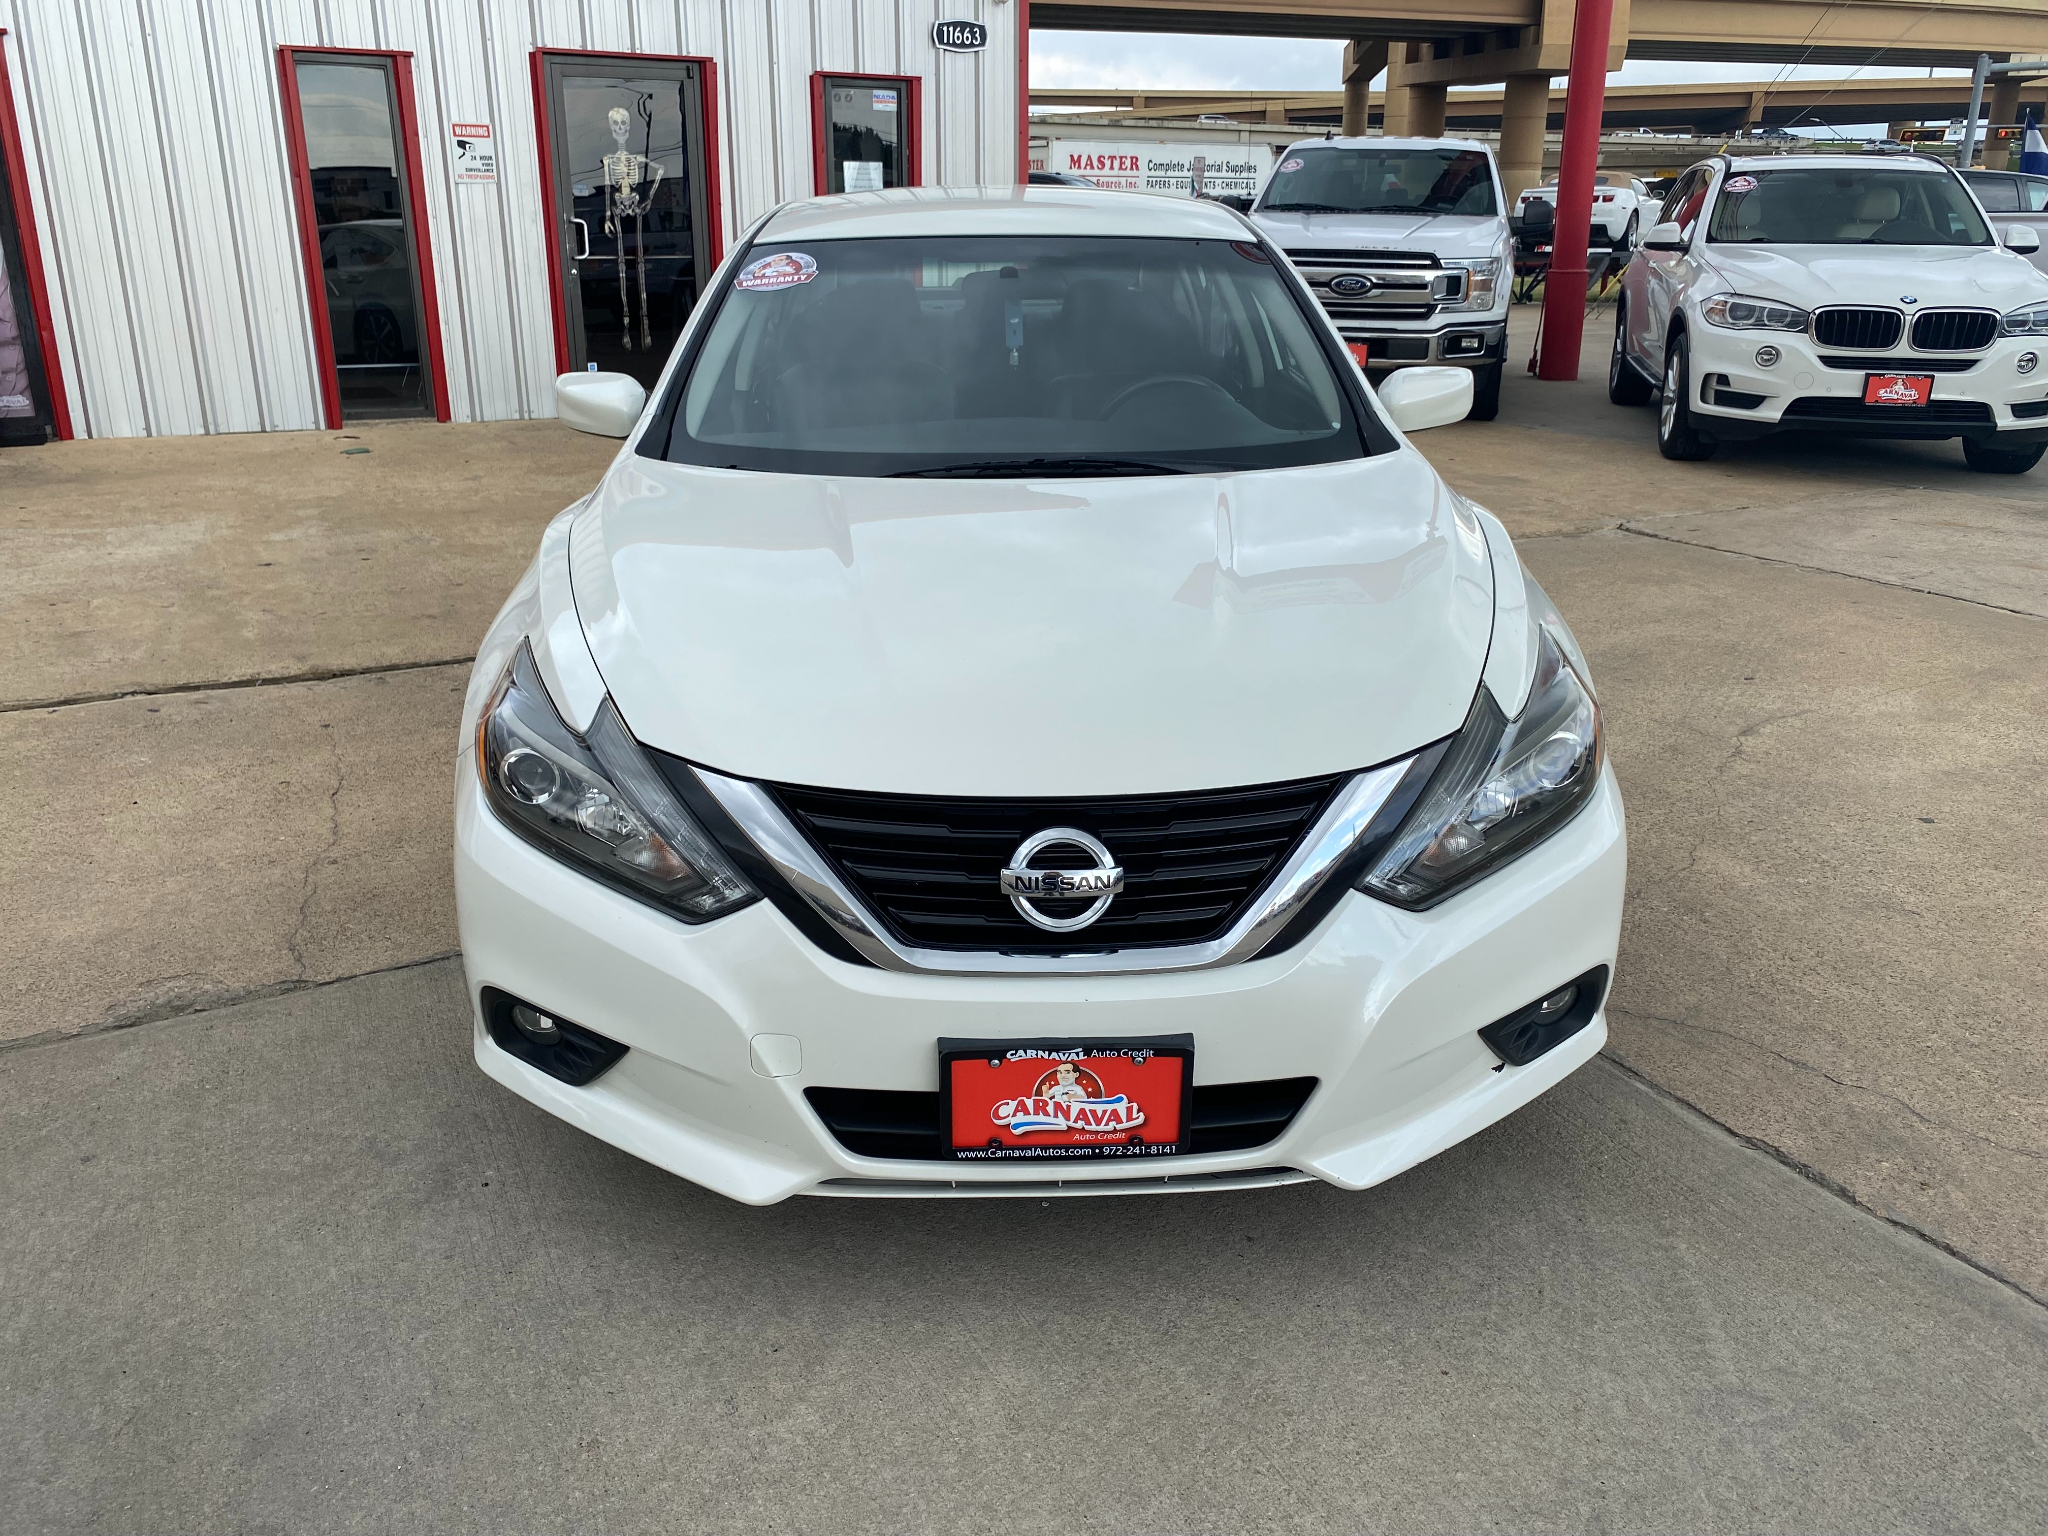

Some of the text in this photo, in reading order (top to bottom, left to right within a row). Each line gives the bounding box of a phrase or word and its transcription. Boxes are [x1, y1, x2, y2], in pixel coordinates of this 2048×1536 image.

[942, 25, 981, 45] 11663
[454, 125, 489, 136] WARNING
[1028, 159, 1044, 171] STER
[1069, 154, 1139, 171] MASTER
[1147, 160, 1185, 175] Complete
[1225, 161, 1257, 176] Supplies
[1096, 178, 1139, 189] Source, Inc.
[1146, 179, 1171, 189] PAPERS
[1220, 180, 1256, 190] CHEMICALS
[742, 275, 807, 286] WARRANTY
[1340, 280, 1361, 290] Ford
[1878, 388, 1918, 399] CARNAVAL
[1014, 875, 1111, 892] NISSAN
[1006, 1048, 1154, 1061] CARNAVAL Auto Credit
[991, 1098, 1142, 1128] CARNAVAL
[1073, 1131, 1126, 1141] Auto Credit
[957, 1145, 1177, 1159] www.CarnavalAutos.com 972-241-8141
